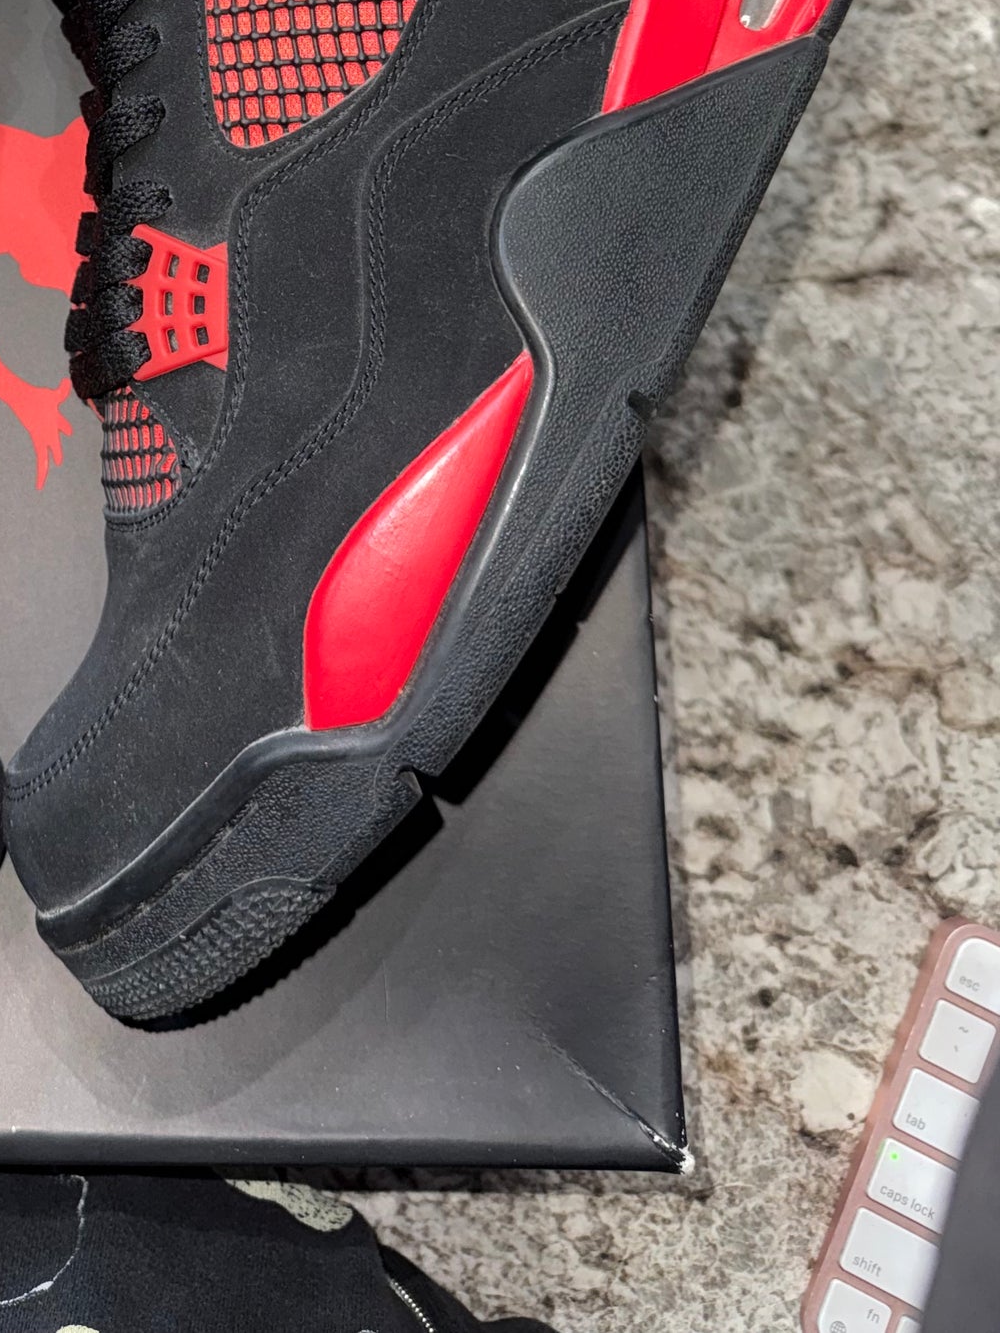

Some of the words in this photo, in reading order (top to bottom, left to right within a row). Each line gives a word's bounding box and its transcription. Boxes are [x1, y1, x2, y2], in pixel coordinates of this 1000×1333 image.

[958, 975, 981, 993] esc
[905, 1112, 926, 1131] tab
[879, 1184, 908, 1207] caps
[910, 1198, 936, 1220] lock
[852, 1255, 883, 1277] shift
[866, 1308, 880, 1325] fn
